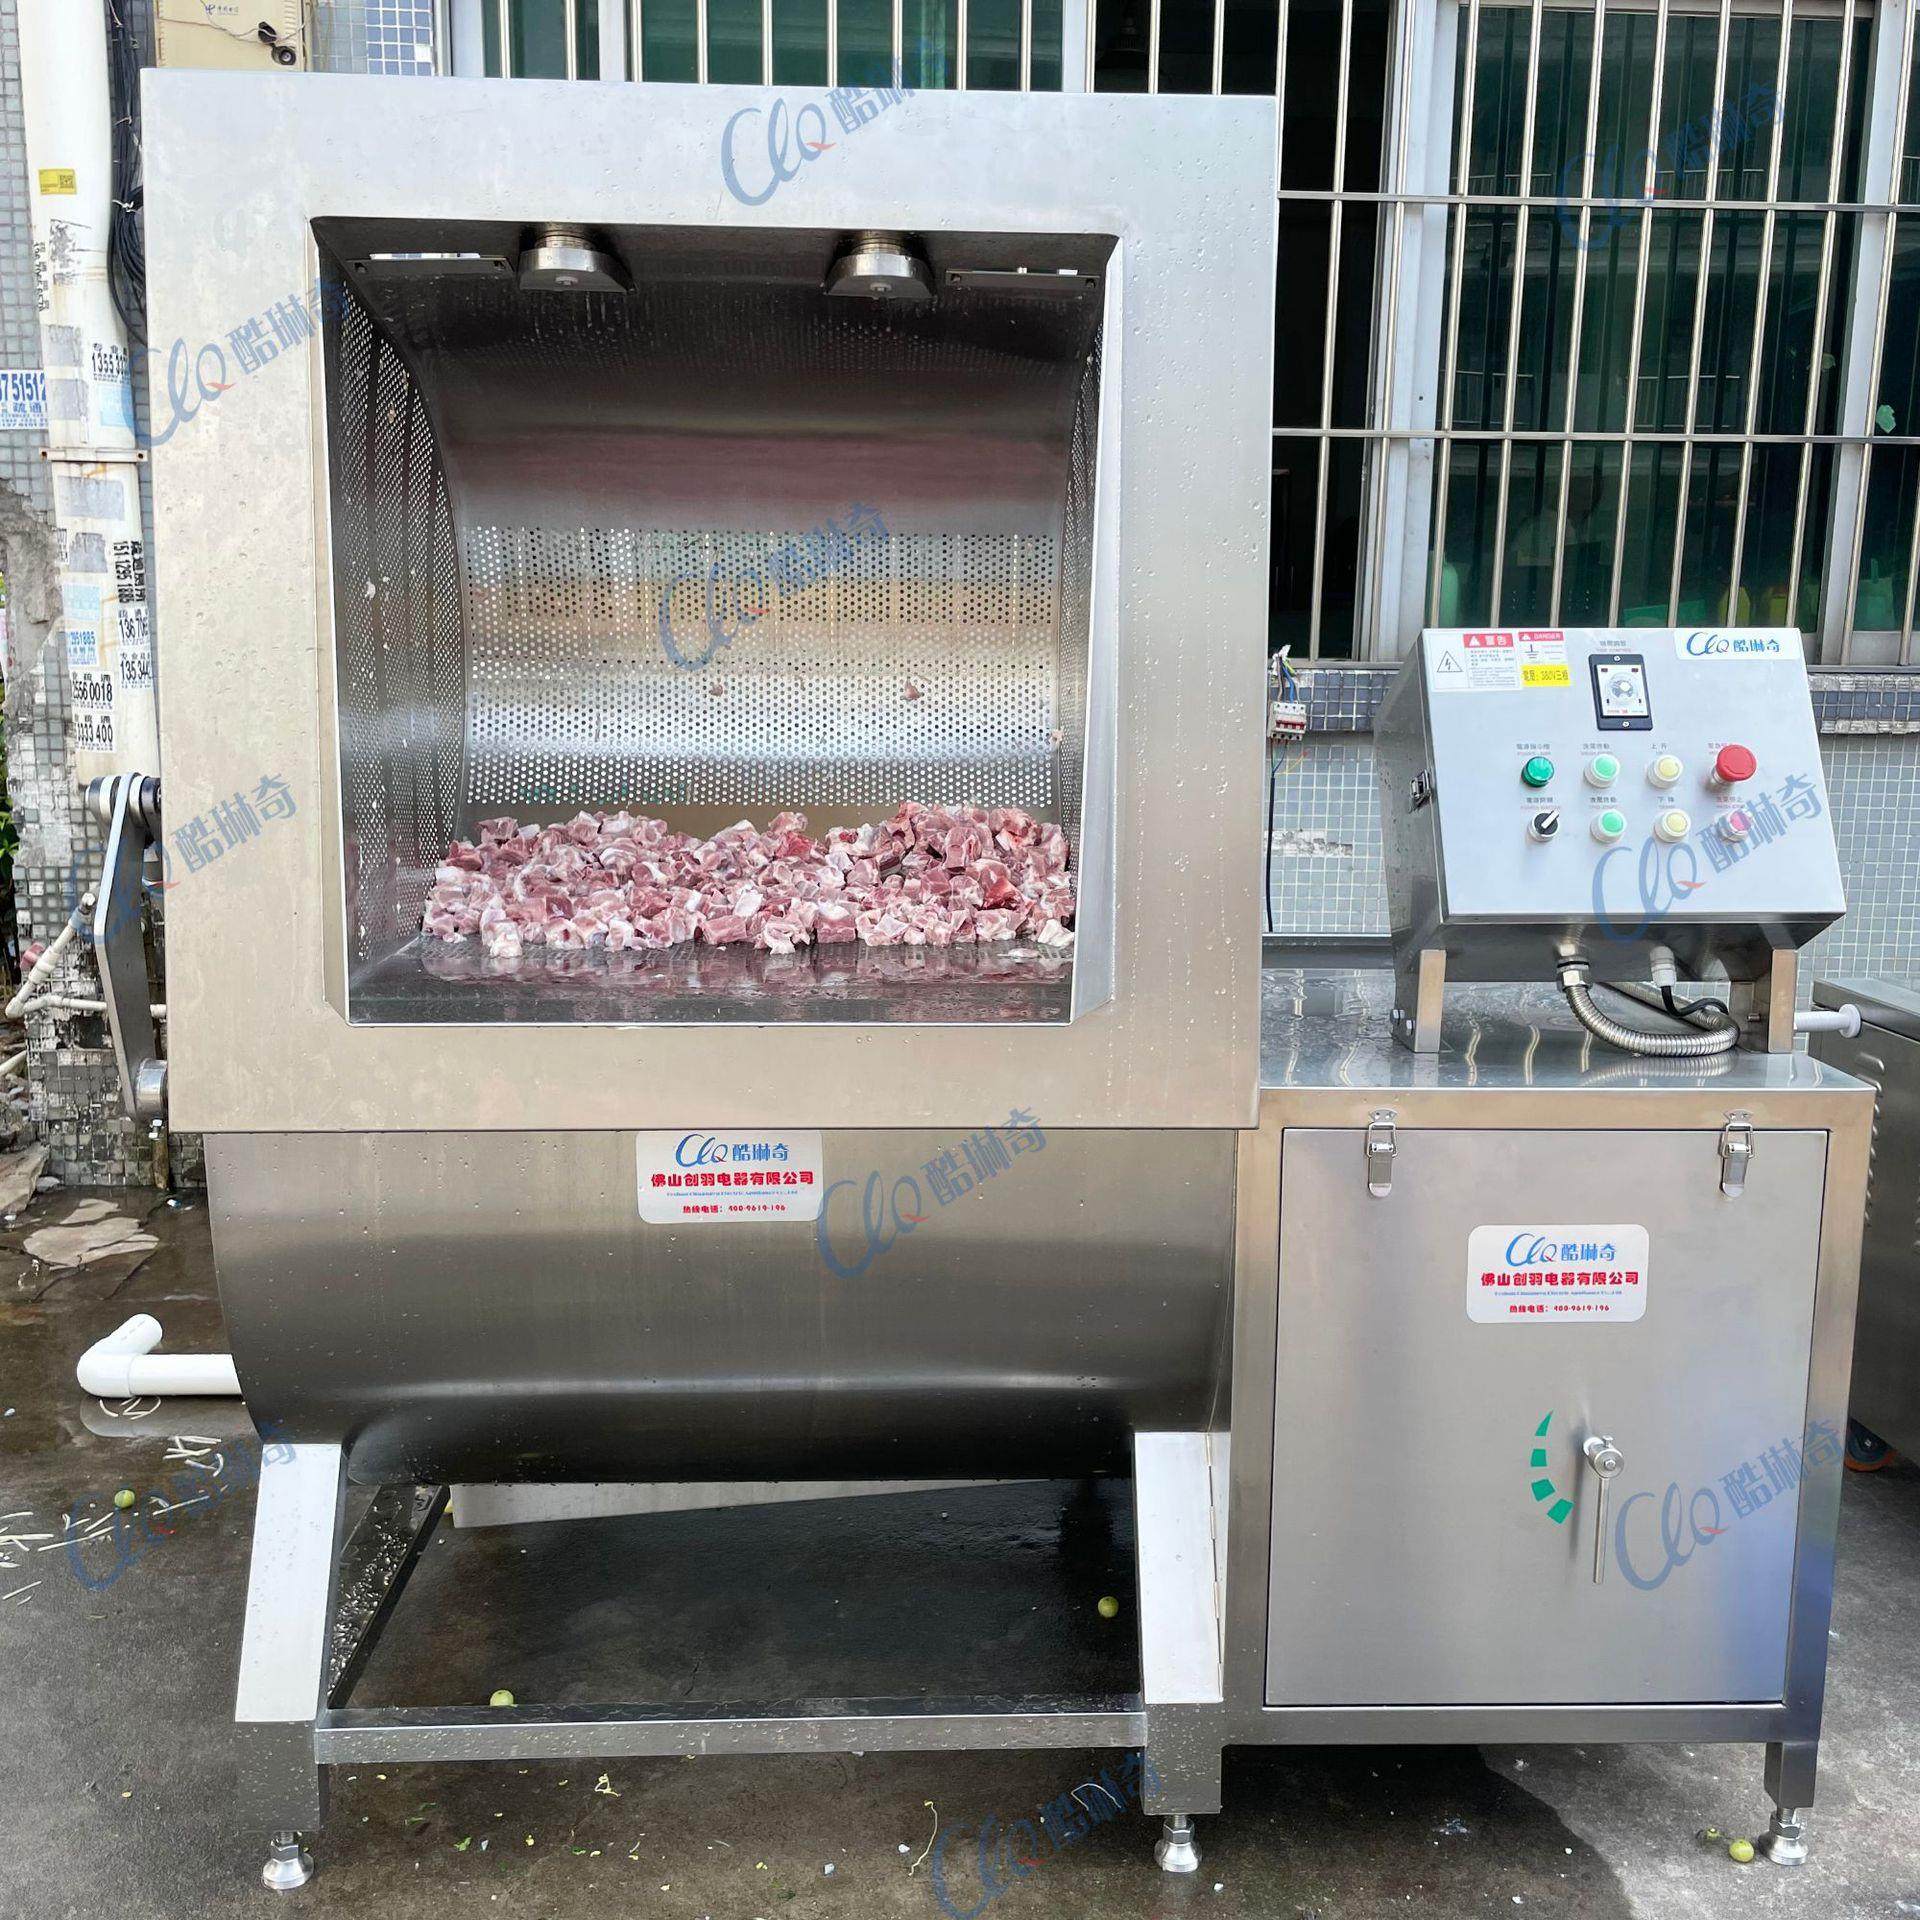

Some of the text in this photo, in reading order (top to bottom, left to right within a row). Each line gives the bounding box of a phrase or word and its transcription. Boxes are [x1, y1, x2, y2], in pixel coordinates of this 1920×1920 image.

[89, 682, 113, 702] 0018
[732, 1143, 790, 1162] 酷琳奇
[651, 1171, 814, 1187] 佛山创羽电器有限公司
[1561, 1243, 1617, 1262] 酷琳奇
[1481, 1271, 1639, 1287] 佛山创羽电器有限公司
